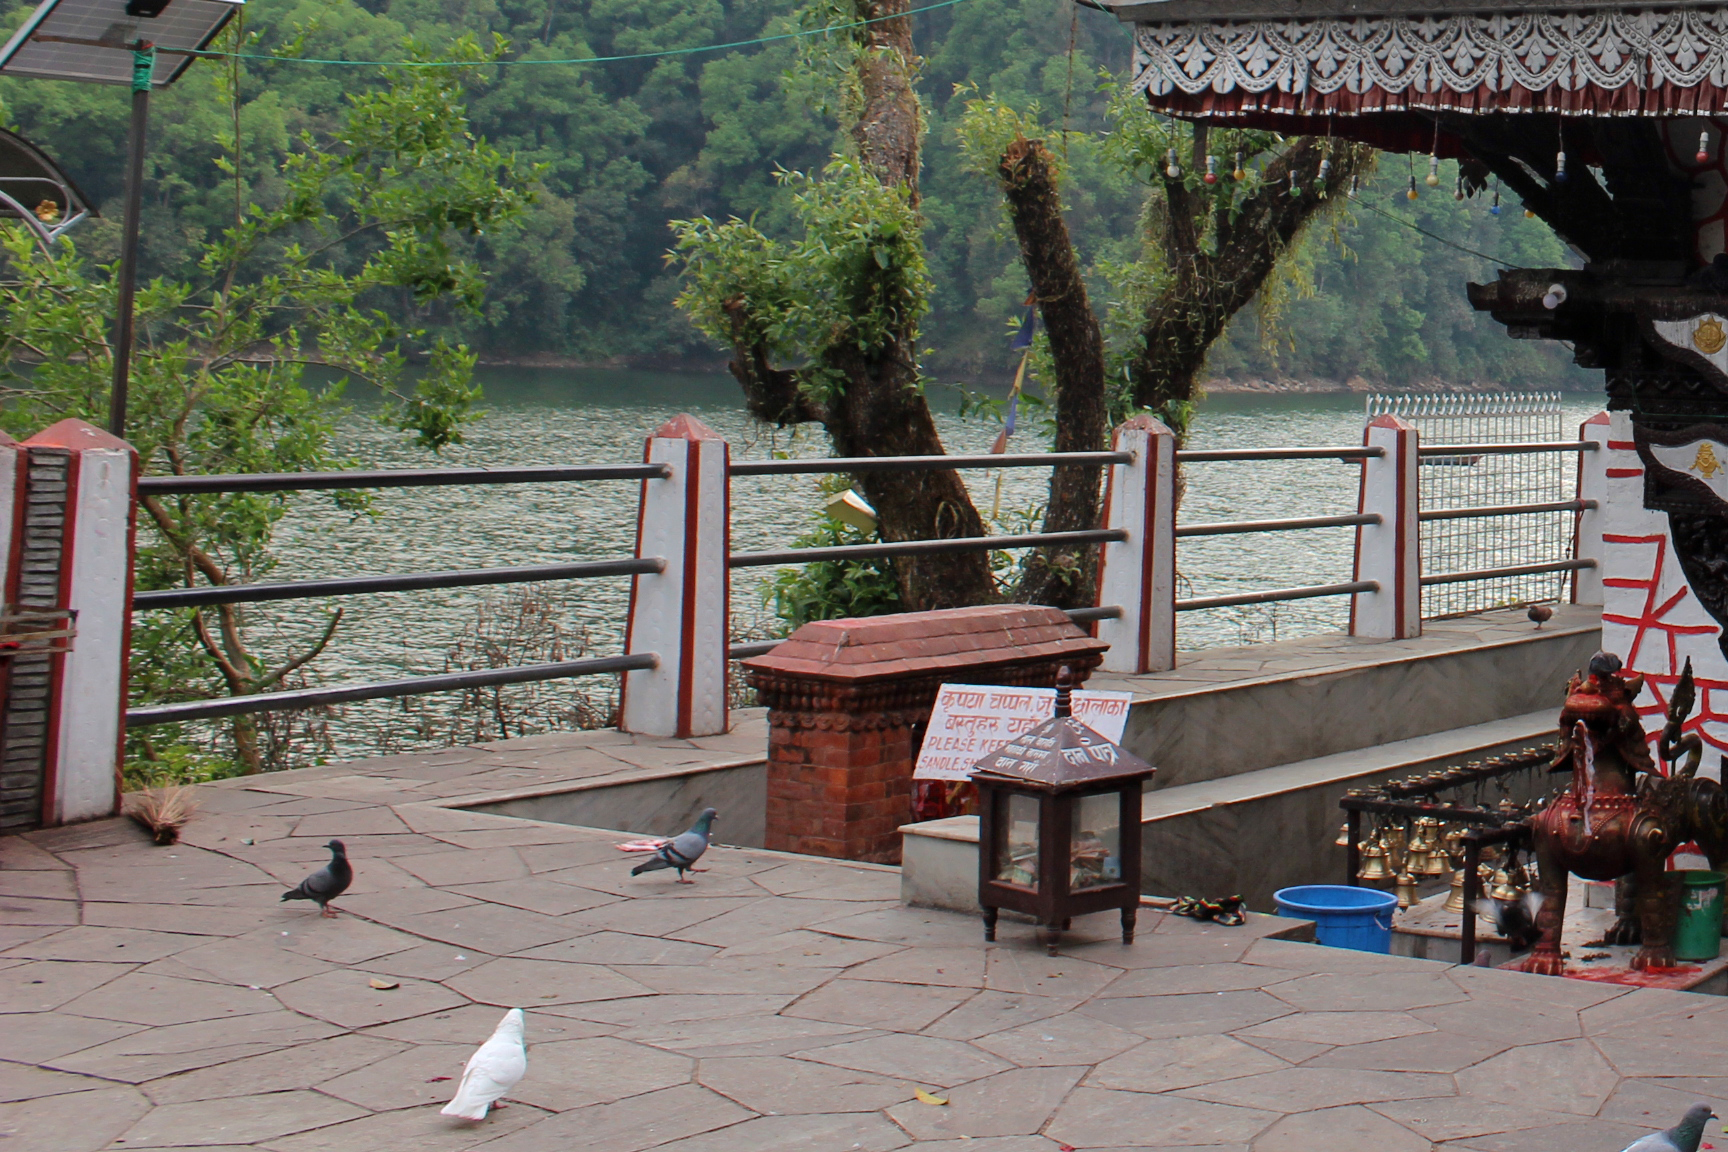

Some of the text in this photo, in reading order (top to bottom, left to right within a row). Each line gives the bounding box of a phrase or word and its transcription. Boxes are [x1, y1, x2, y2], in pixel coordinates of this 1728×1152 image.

[941, 690, 987, 712] कृपया
[1037, 695, 1056, 718] जु
[927, 735, 977, 752] PLEASE
[979, 738, 1012, 754] KEE
[1088, 742, 1120, 767] पात्र
